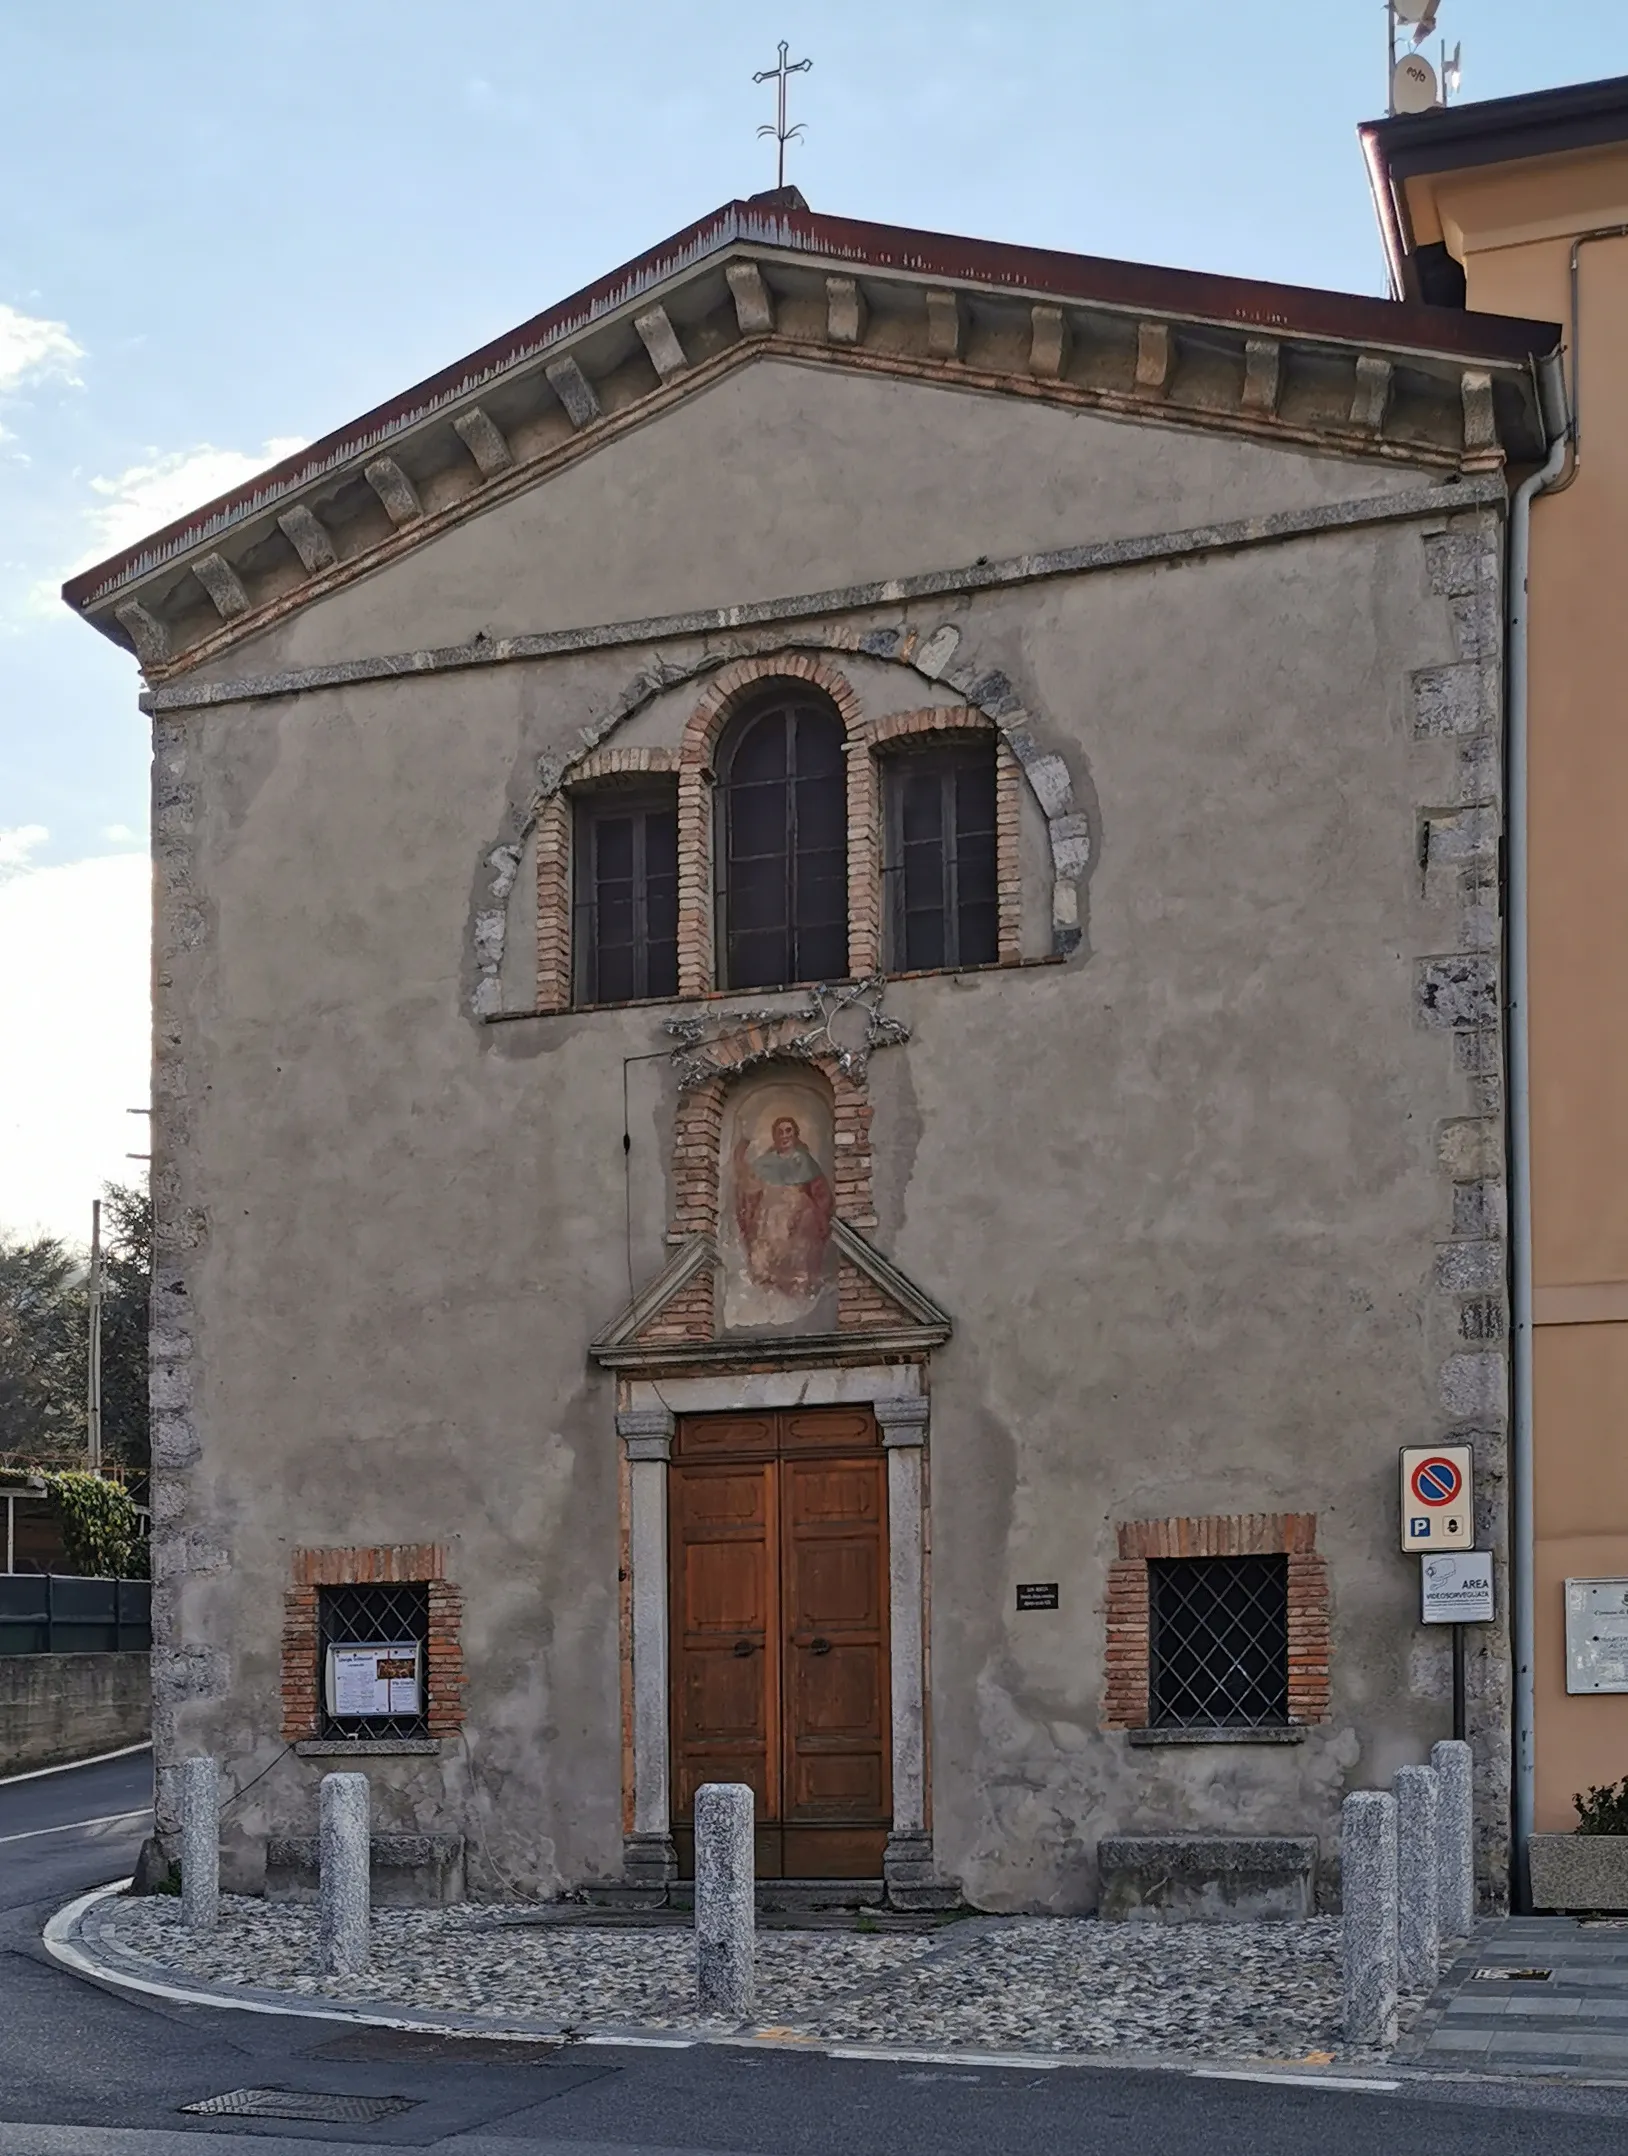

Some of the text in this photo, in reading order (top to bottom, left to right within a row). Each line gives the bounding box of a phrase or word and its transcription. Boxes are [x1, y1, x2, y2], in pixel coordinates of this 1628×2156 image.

[1414, 1519, 1427, 1536] P
[1462, 1579, 1489, 1590] AREA
[1426, 1591, 1489, 1600] VIDEOSORVEGLIATA
